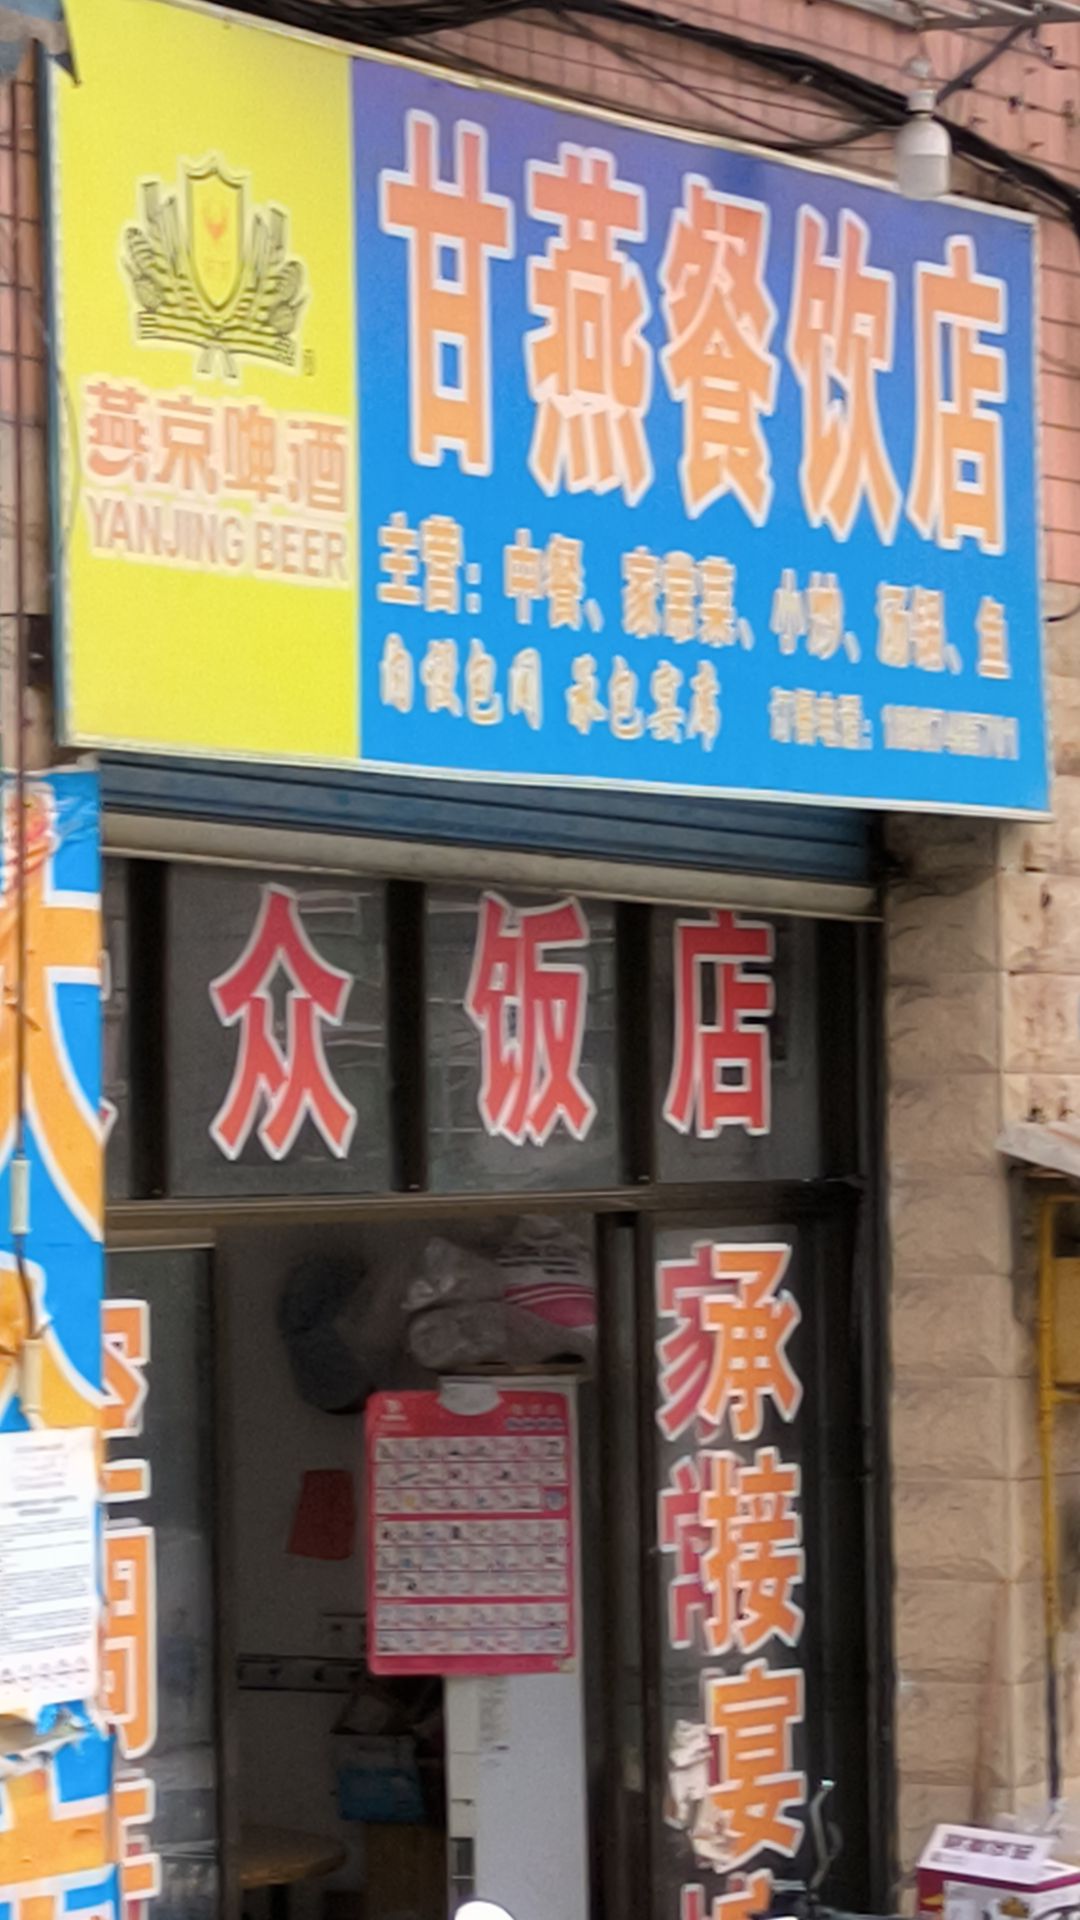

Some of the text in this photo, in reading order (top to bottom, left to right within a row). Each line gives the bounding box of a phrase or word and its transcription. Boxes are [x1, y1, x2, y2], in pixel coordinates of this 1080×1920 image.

[84, 380, 349, 516] 燕京啤酒
[379, 108, 1008, 557] 甘燕餐饮店
[86, 493, 351, 584] YANJING BEER
[102, 882, 777, 1161] 众饭店
[700, 1242, 805, 1920] 承接宴
